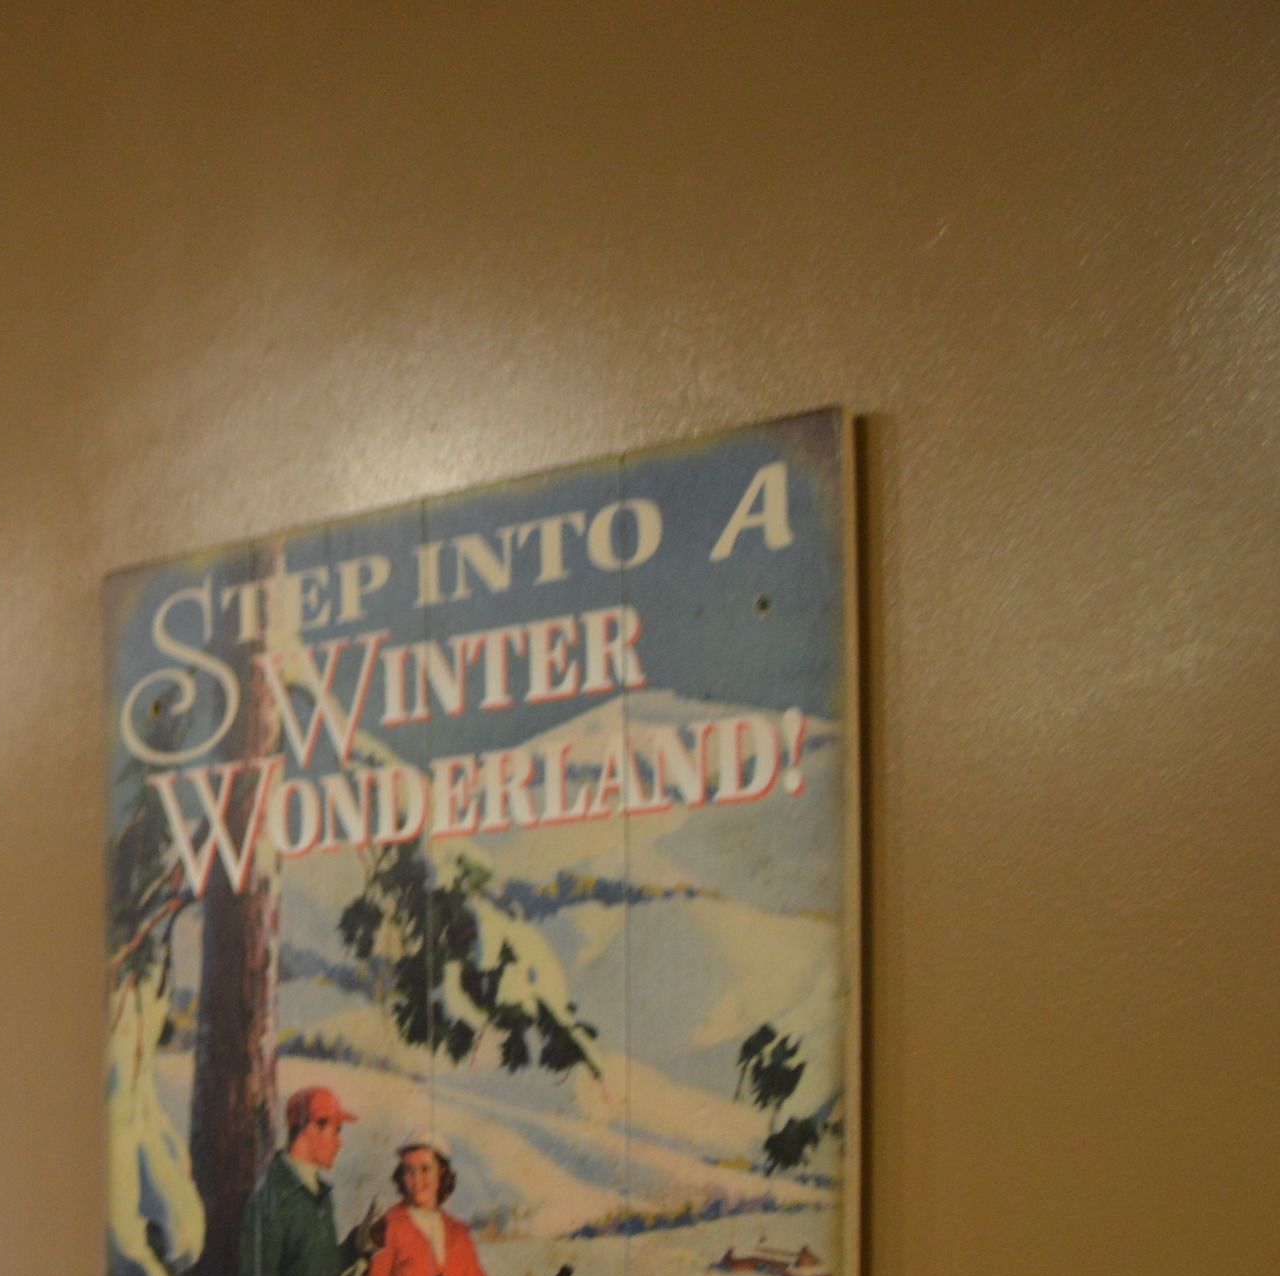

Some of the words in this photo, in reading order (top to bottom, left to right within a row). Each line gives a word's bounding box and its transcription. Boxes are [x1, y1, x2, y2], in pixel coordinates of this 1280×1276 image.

[120, 554, 391, 765] STEP
[411, 497, 663, 608] INTO
[708, 461, 794, 561] A
[251, 605, 647, 770] WINTER
[146, 706, 808, 900] WONDERLAND!
